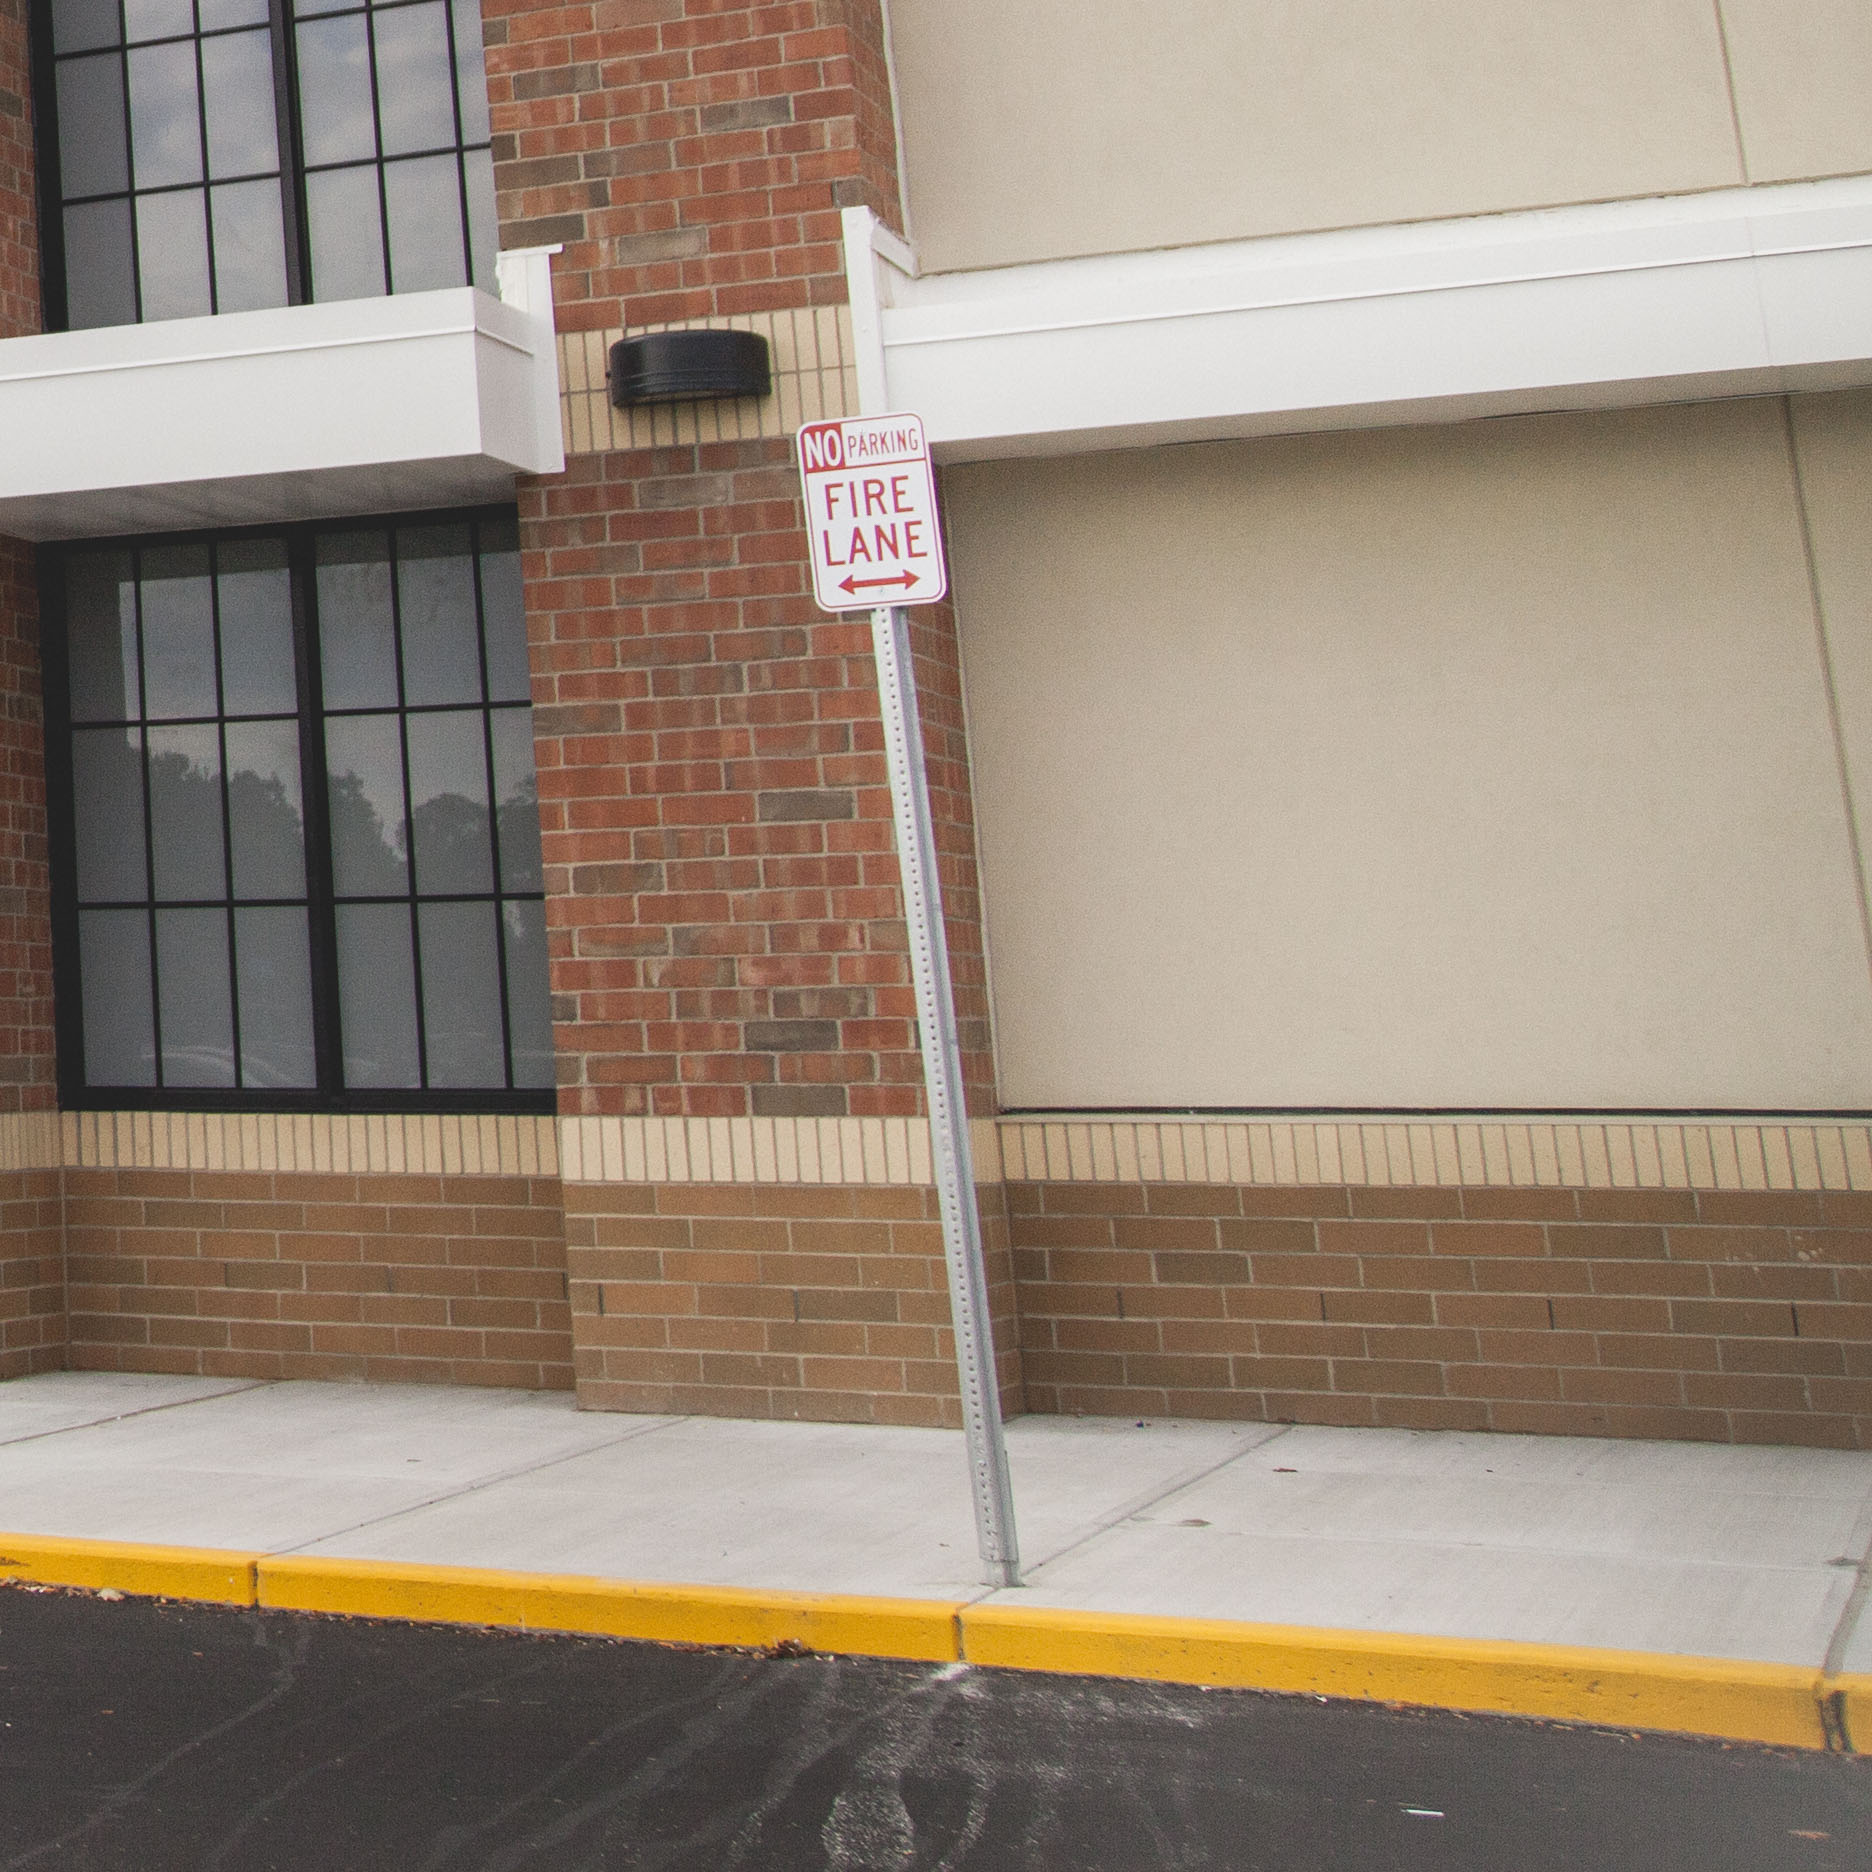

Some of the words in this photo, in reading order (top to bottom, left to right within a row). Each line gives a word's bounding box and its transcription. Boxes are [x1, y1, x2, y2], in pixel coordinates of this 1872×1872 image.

[804, 428, 843, 469] NO
[848, 428, 919, 458] PARKING
[824, 475, 914, 520] FIRE
[823, 520, 928, 566] LANE
